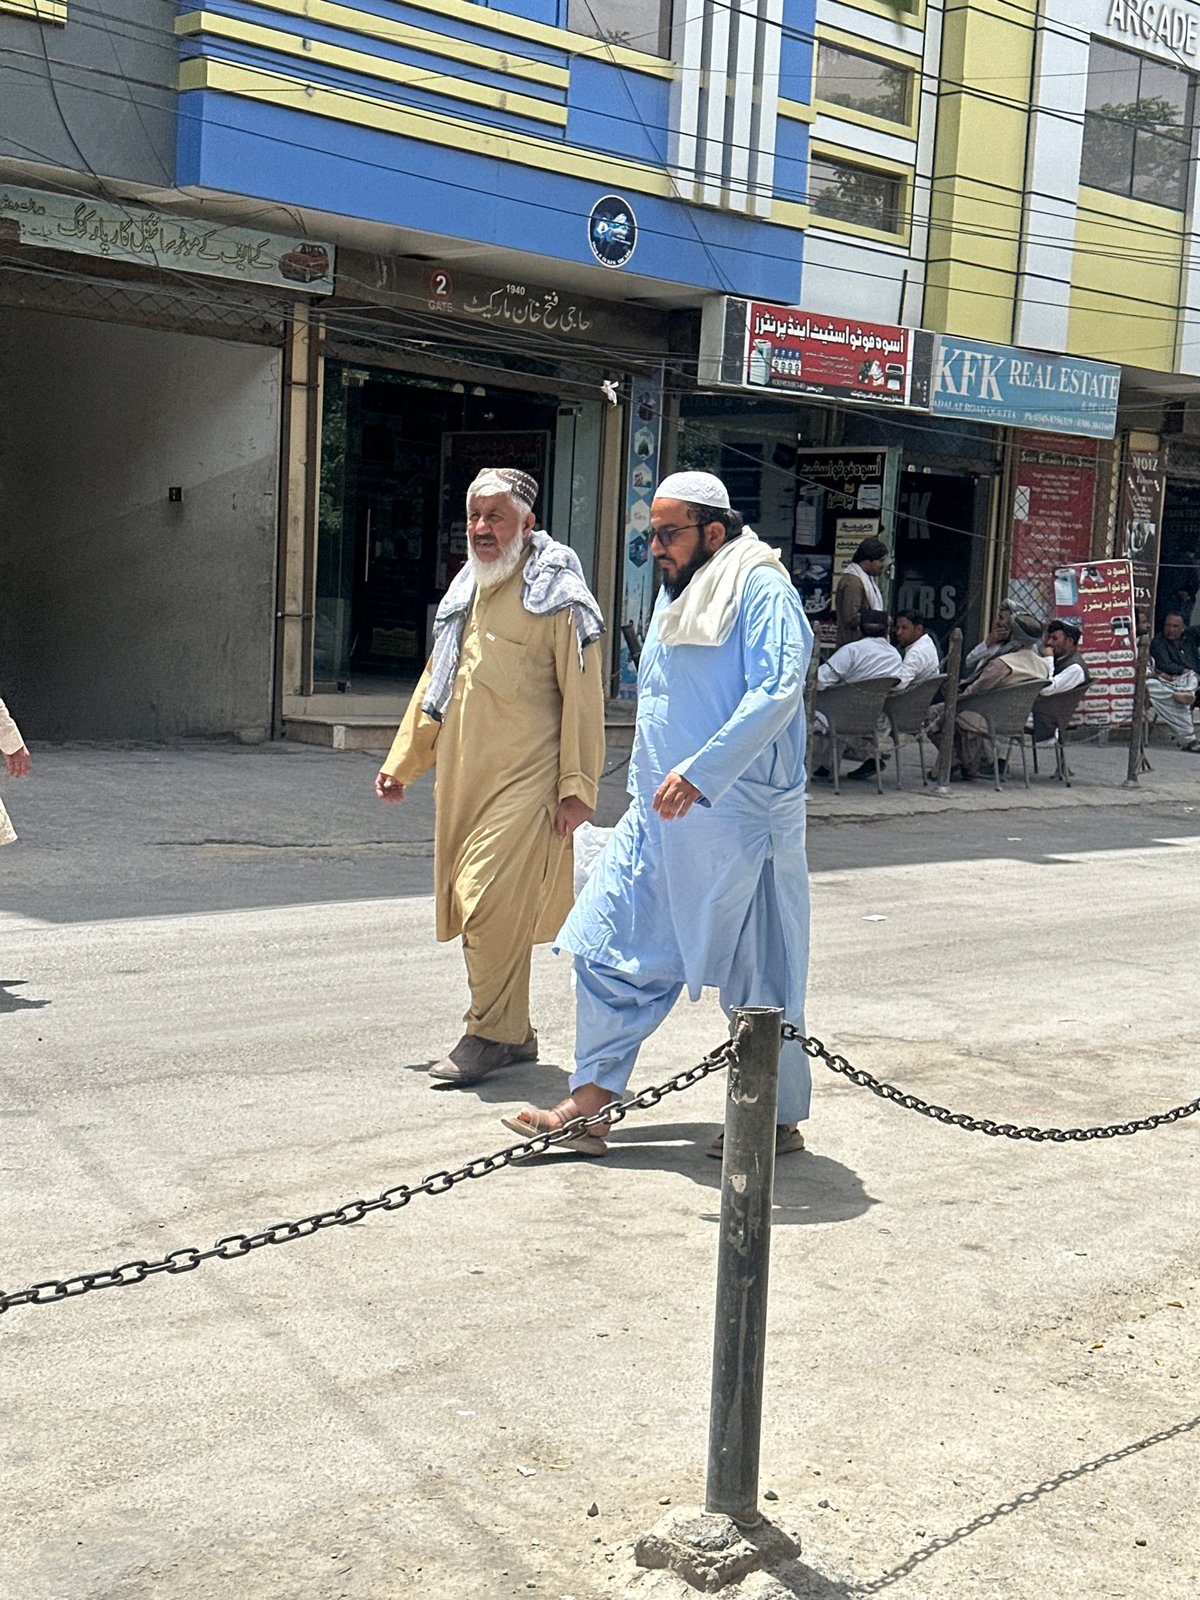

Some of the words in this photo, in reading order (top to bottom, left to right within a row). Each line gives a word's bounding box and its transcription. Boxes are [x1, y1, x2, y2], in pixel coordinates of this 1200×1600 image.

[1106, 0, 1198, 56] ARCADE
[435, 275, 447, 295] 2
[505, 283, 526, 296] 1940
[428, 300, 453, 313] GATE
[463, 288, 511, 319] مارکیٹ
[512, 298, 541, 324] خان
[543, 291, 559, 329] فتح
[559, 305, 591, 332] حاجی
[754, 311, 787, 341] پرنٹرز
[787, 315, 810, 341] اینڈ
[933, 345, 1006, 402] KFK
[1009, 359, 1055, 391] REAL
[1058, 367, 1120, 400] ESTATE
